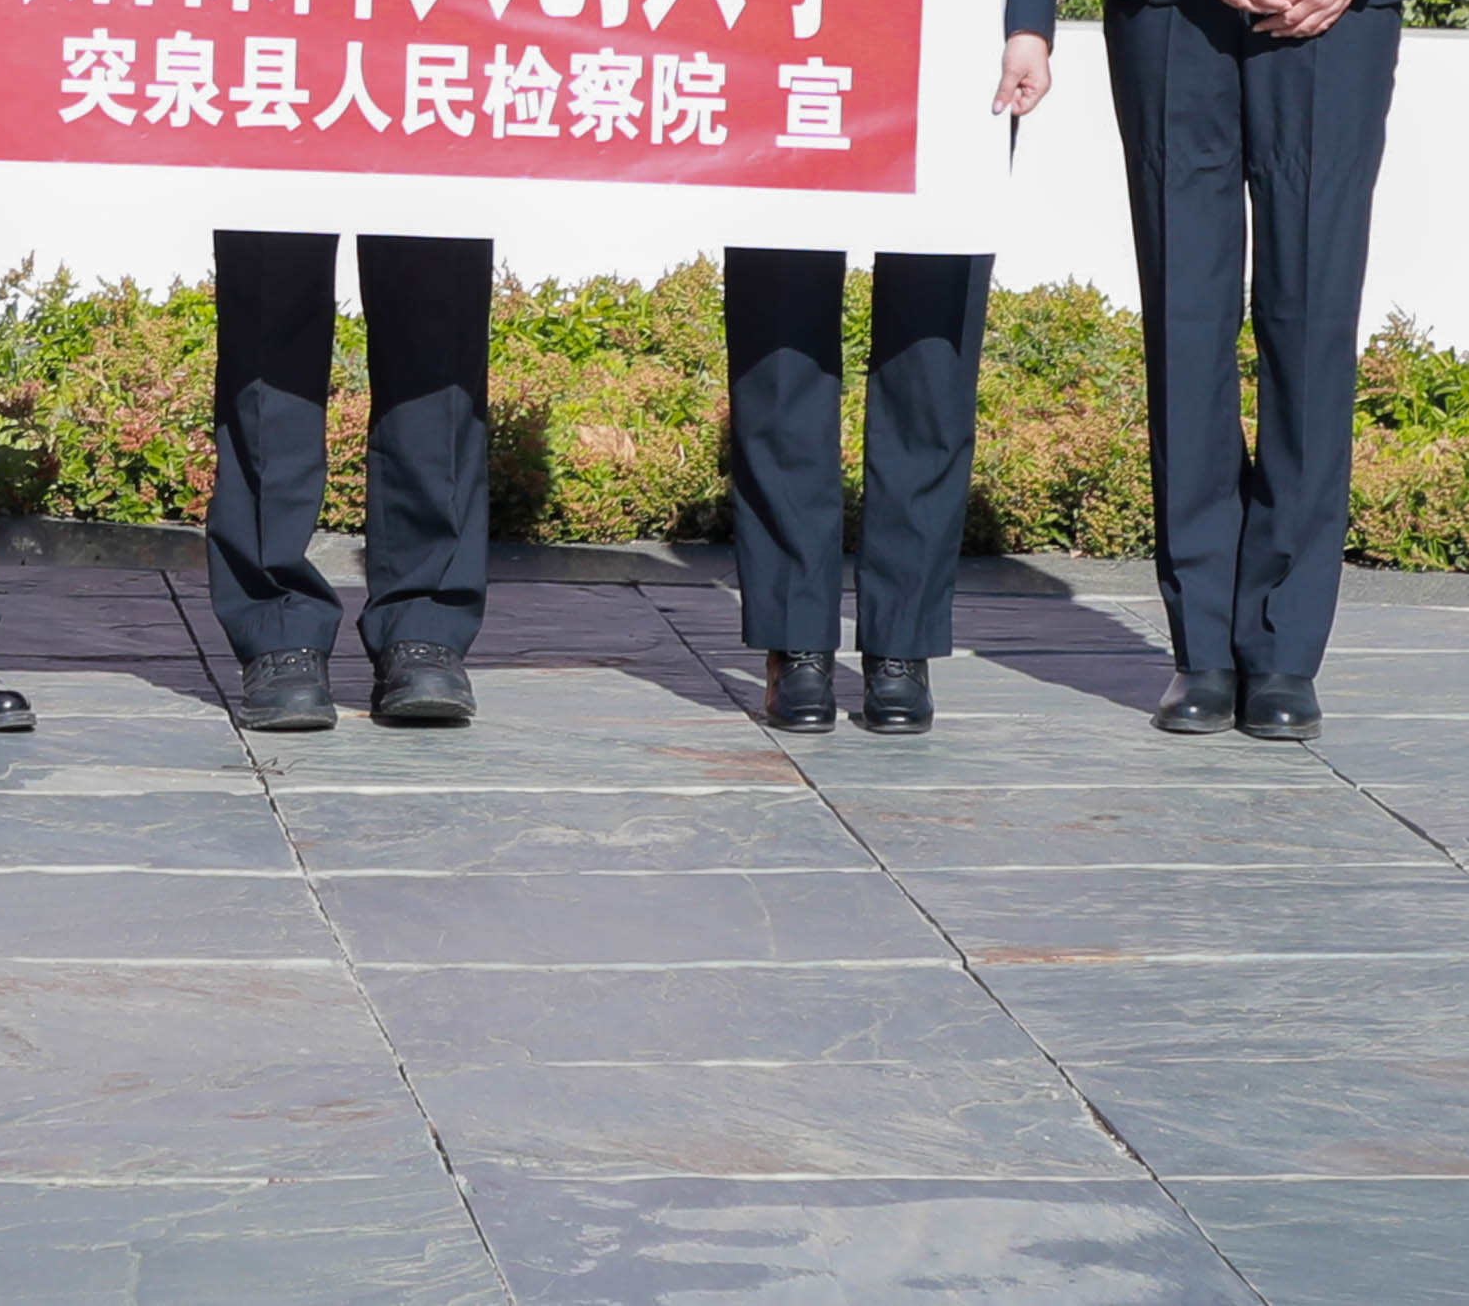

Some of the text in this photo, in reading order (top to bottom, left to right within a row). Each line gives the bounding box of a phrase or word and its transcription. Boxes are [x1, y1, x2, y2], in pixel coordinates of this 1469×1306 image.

[58, 28, 854, 151] 突泉县人民检察院 宣
